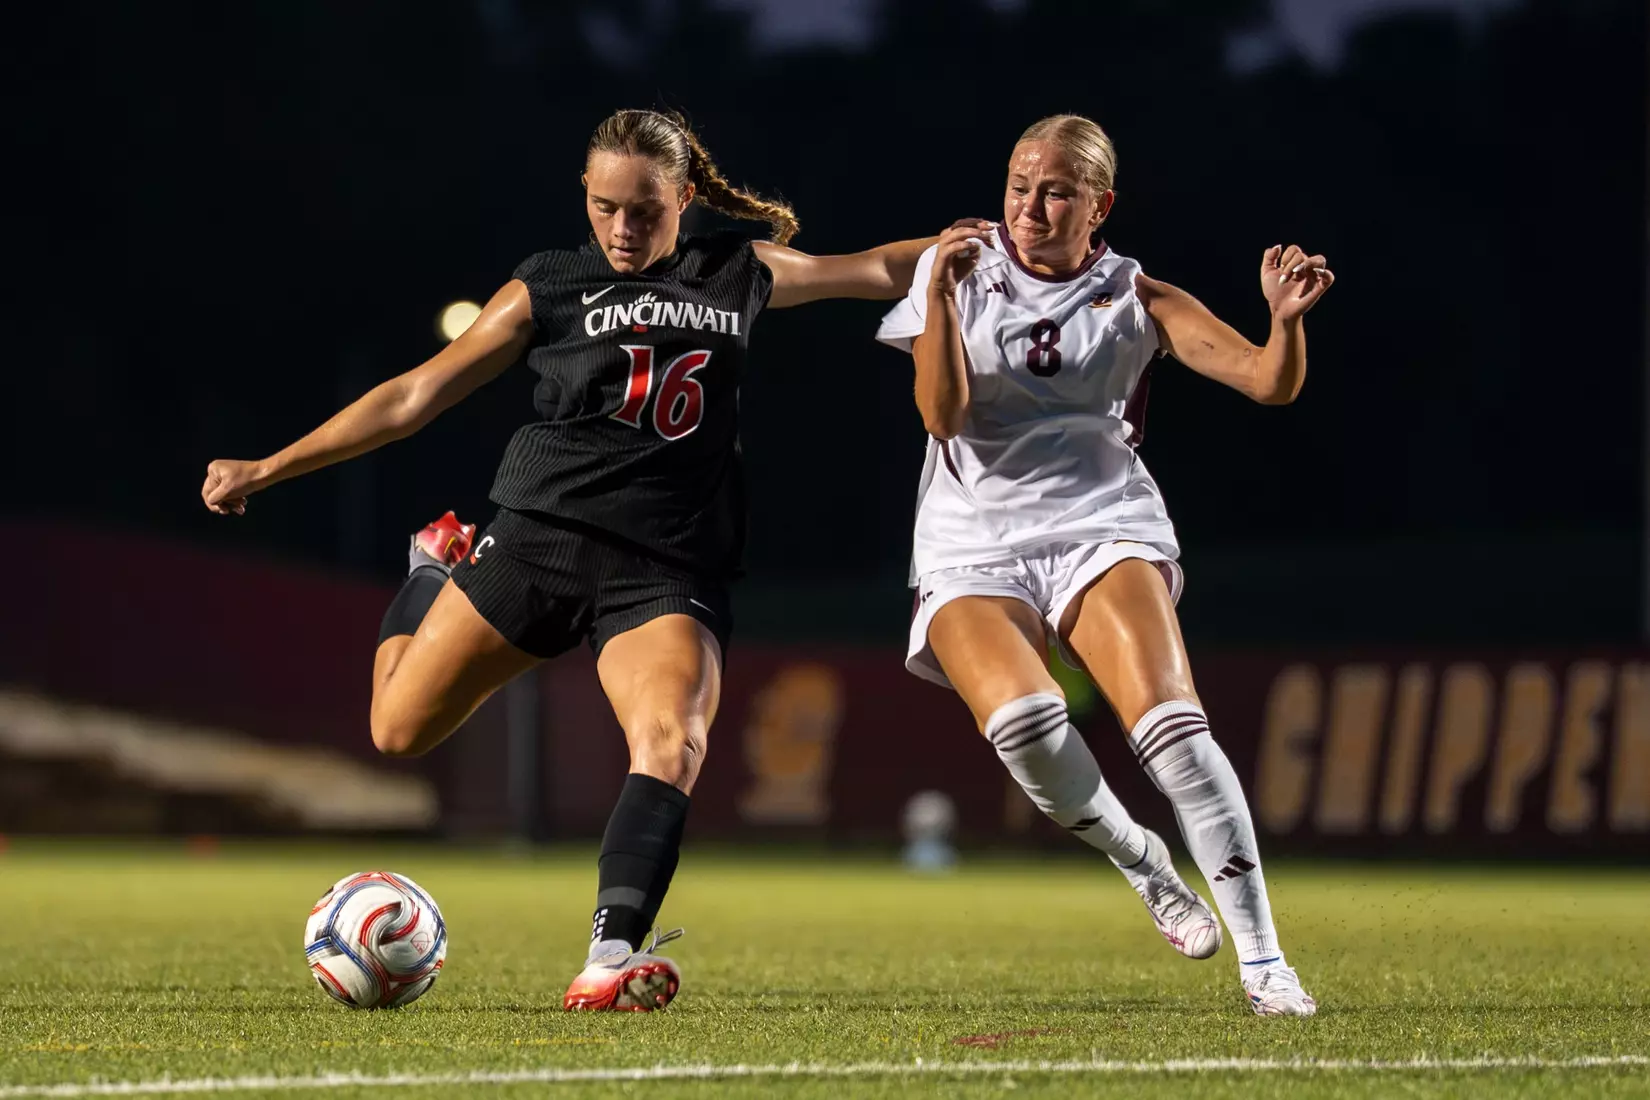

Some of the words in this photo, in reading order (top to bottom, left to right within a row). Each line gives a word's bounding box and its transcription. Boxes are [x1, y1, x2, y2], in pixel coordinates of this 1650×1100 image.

[584, 299, 742, 337] CINCINNATI
[1026, 318, 1062, 377] 8
[609, 344, 712, 441] 16
